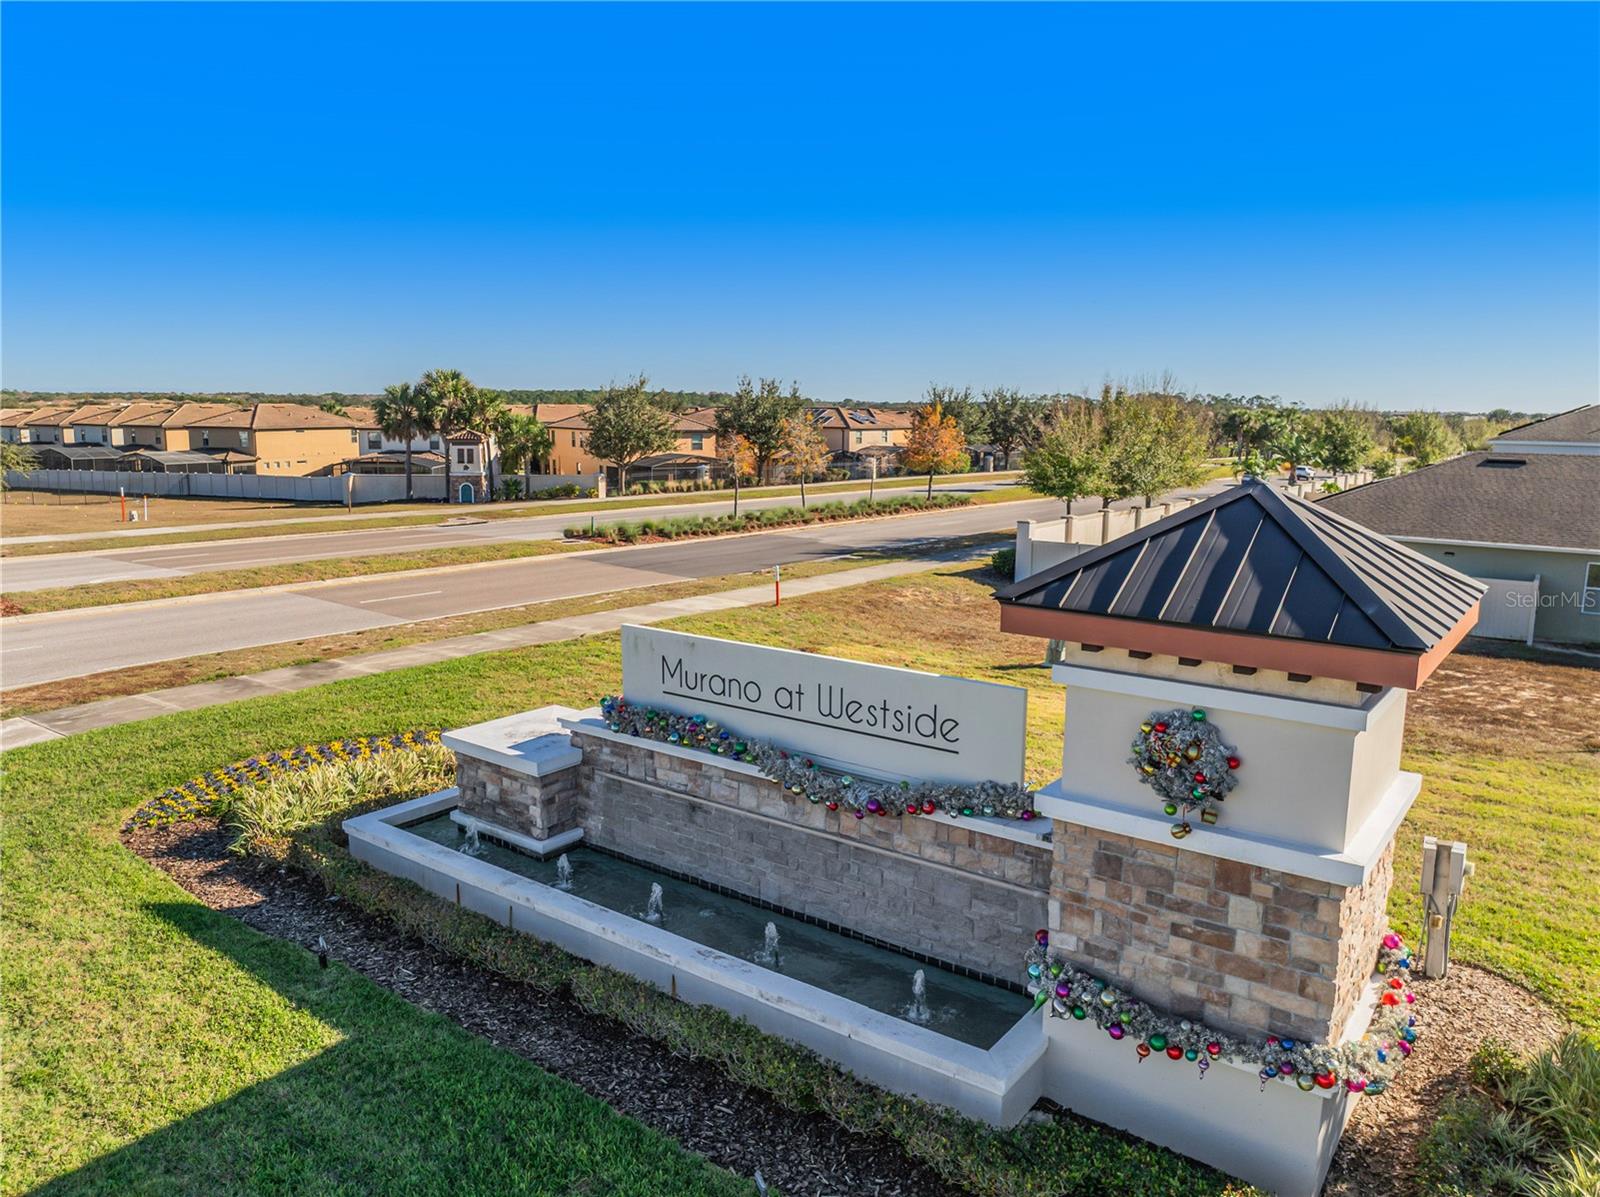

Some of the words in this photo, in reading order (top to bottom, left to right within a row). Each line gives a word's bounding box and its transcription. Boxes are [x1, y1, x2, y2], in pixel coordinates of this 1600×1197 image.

[661, 655, 762, 703] Murano
[774, 683, 804, 712] at
[817, 683, 960, 743] Westside
